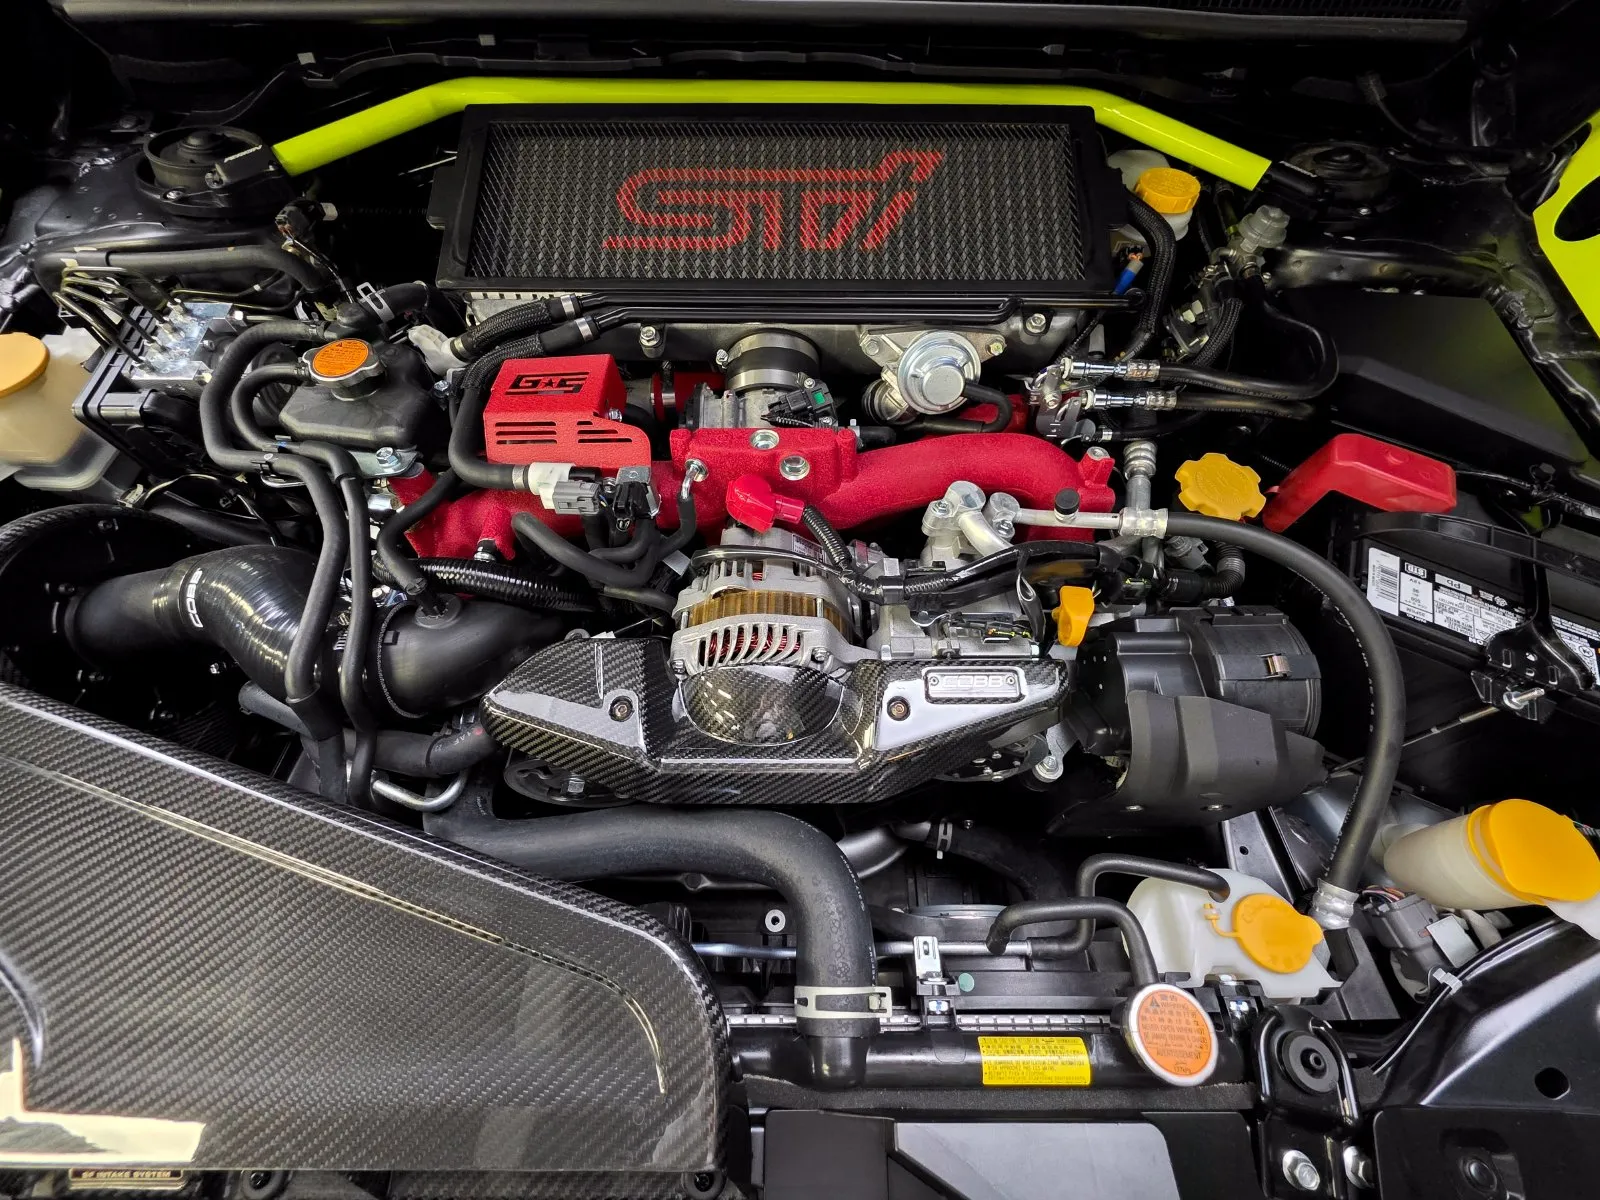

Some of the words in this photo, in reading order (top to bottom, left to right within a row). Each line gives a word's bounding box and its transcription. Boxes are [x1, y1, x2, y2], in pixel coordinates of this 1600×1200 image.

[943, 675, 1003, 689] COBB
[97, 1170, 131, 1179] INTAKE
[133, 1170, 171, 1179] SYSTEM
